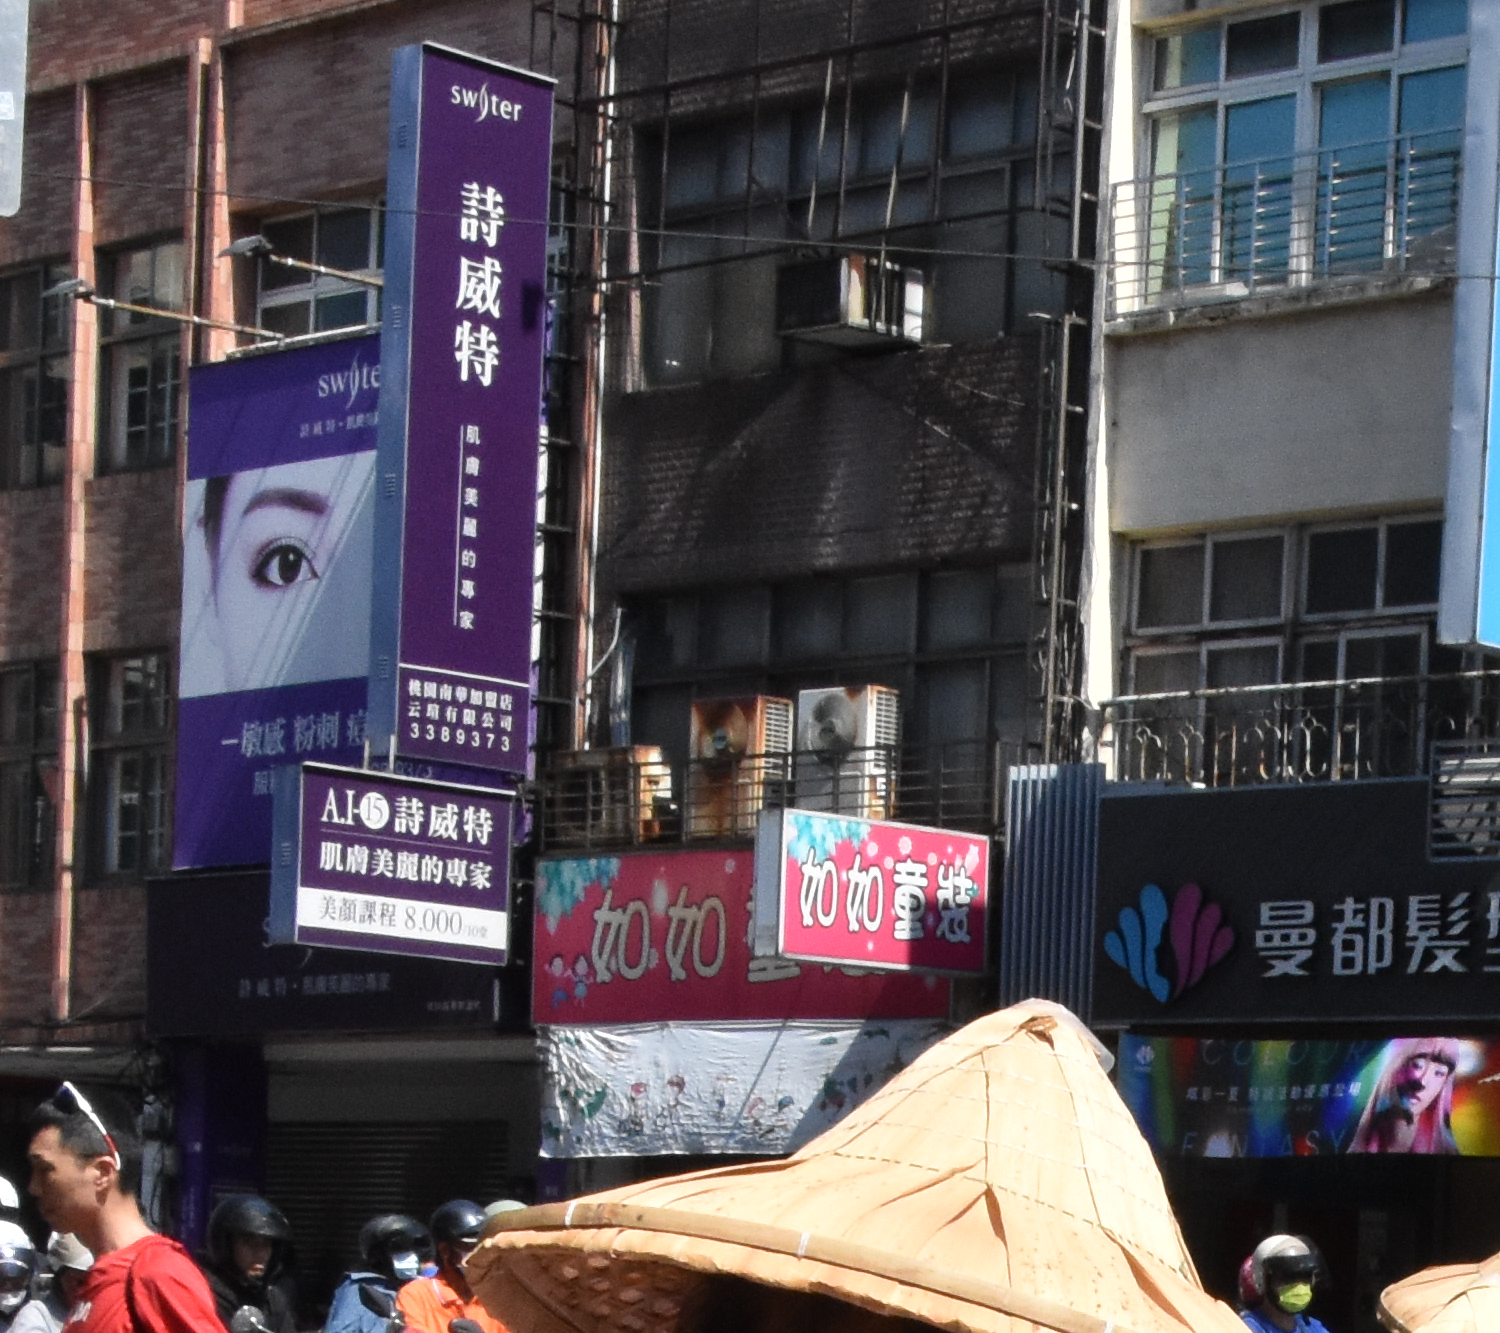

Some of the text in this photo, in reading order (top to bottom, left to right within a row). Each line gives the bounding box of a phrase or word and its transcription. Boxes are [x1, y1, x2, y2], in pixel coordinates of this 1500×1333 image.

[455, 182, 504, 386] 詩威特
[410, 724, 510, 751] 3389373
[320, 841, 492, 890] 肌膚美麗的專家
[799, 847, 973, 943] 如如童裝
